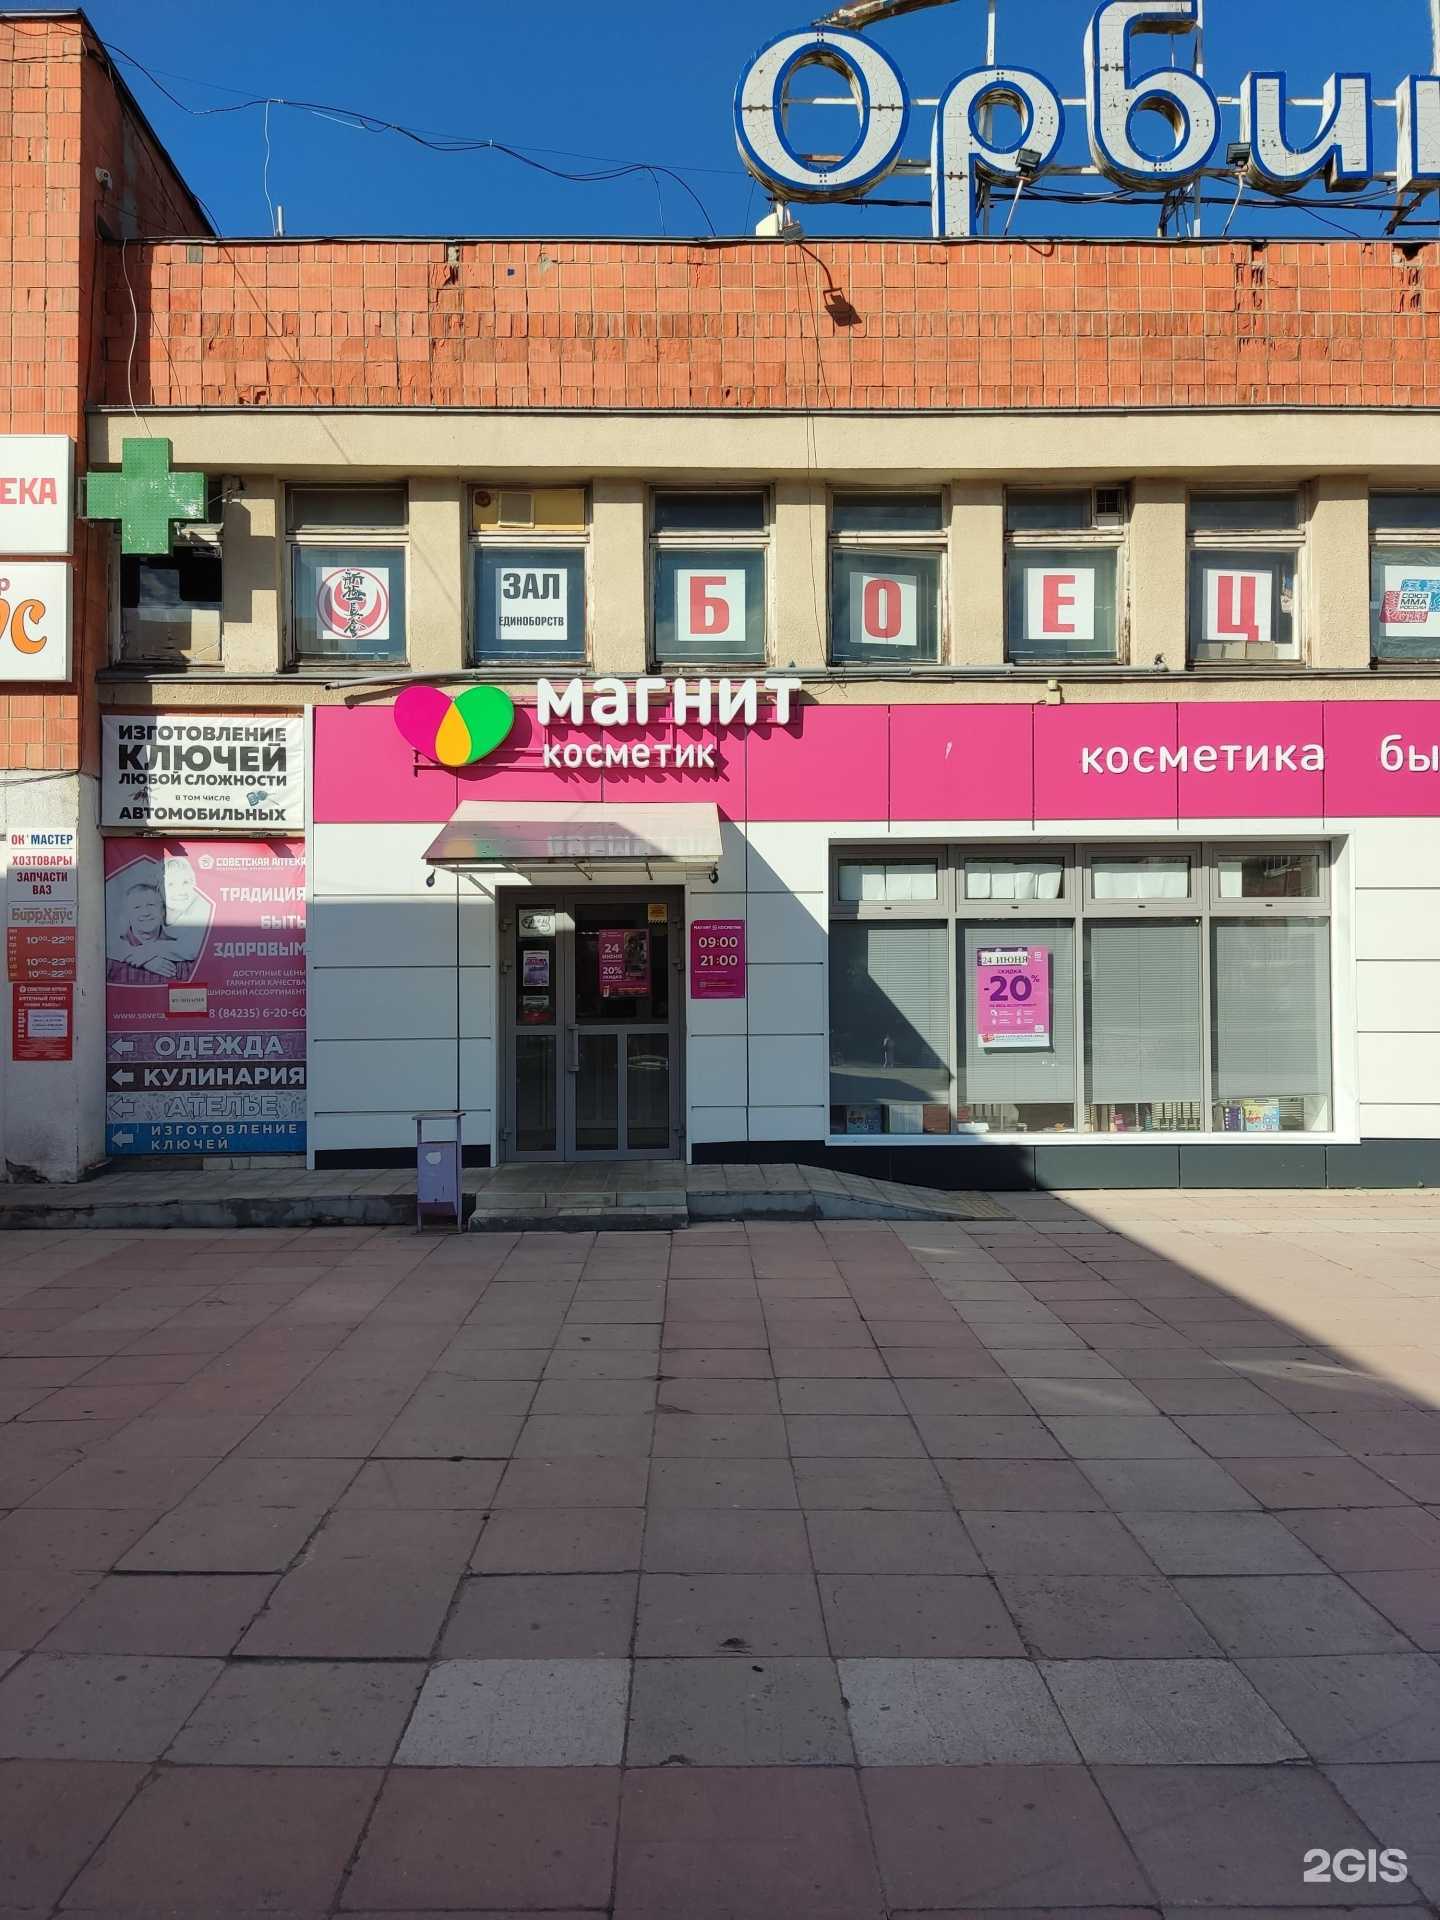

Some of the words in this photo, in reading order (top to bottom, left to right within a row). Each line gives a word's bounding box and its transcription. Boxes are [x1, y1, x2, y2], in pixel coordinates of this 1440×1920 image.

[503, 573, 559, 599] ЗАЛ
[499, 616, 564, 626] ЕДИНОБОРСТВ
[536, 678, 802, 726] магнит
[118, 725, 287, 742] ИЗГОТОВЛЕНИЕ
[118, 743, 287, 773] КЛЮЧЕЙ
[542, 742, 715, 769] косметик
[1081, 743, 1325, 774] косметика
[1380, 734, 1440, 771] бы
[118, 771, 182, 785] ЛЮБОЙ
[185, 773, 287, 786] СЛОЖНОСТИ
[203, 794, 231, 802] числе
[119, 807, 286, 821] АВТОМОБИЛЬНЫХ
[11, 834, 25, 845] ОК
[30, 834, 73, 845] МАСТЕР
[12, 856, 73, 866] ХОЗТОВАРЫ
[16, 872, 68, 882] ЗАПЧАСТИ
[32, 885, 52, 895] ВАЗ
[219, 887, 306, 903] ТРАДИЦИЯ
[260, 915, 306, 929] БЫТЬ
[604, 943, 619, 953] 24
[698, 936, 738, 948] 09:00
[214, 942, 307, 958] ЗДОРОВЫМ
[700, 955, 738, 966] 21:00
[602, 966, 623, 975] 20%
[112, 1011, 166, 1021] www.soveta
[155, 1036, 284, 1058] ОДЕЖДА
[144, 1067, 305, 1087] КУЛИНАРИЯ
[166, 1095, 279, 1118] АТЕЛЬЕ
[151, 1123, 297, 1136] ИЗГОТОВЛЕНИЕ
[151, 1137, 228, 1150] КЛЮЧЕЙ
